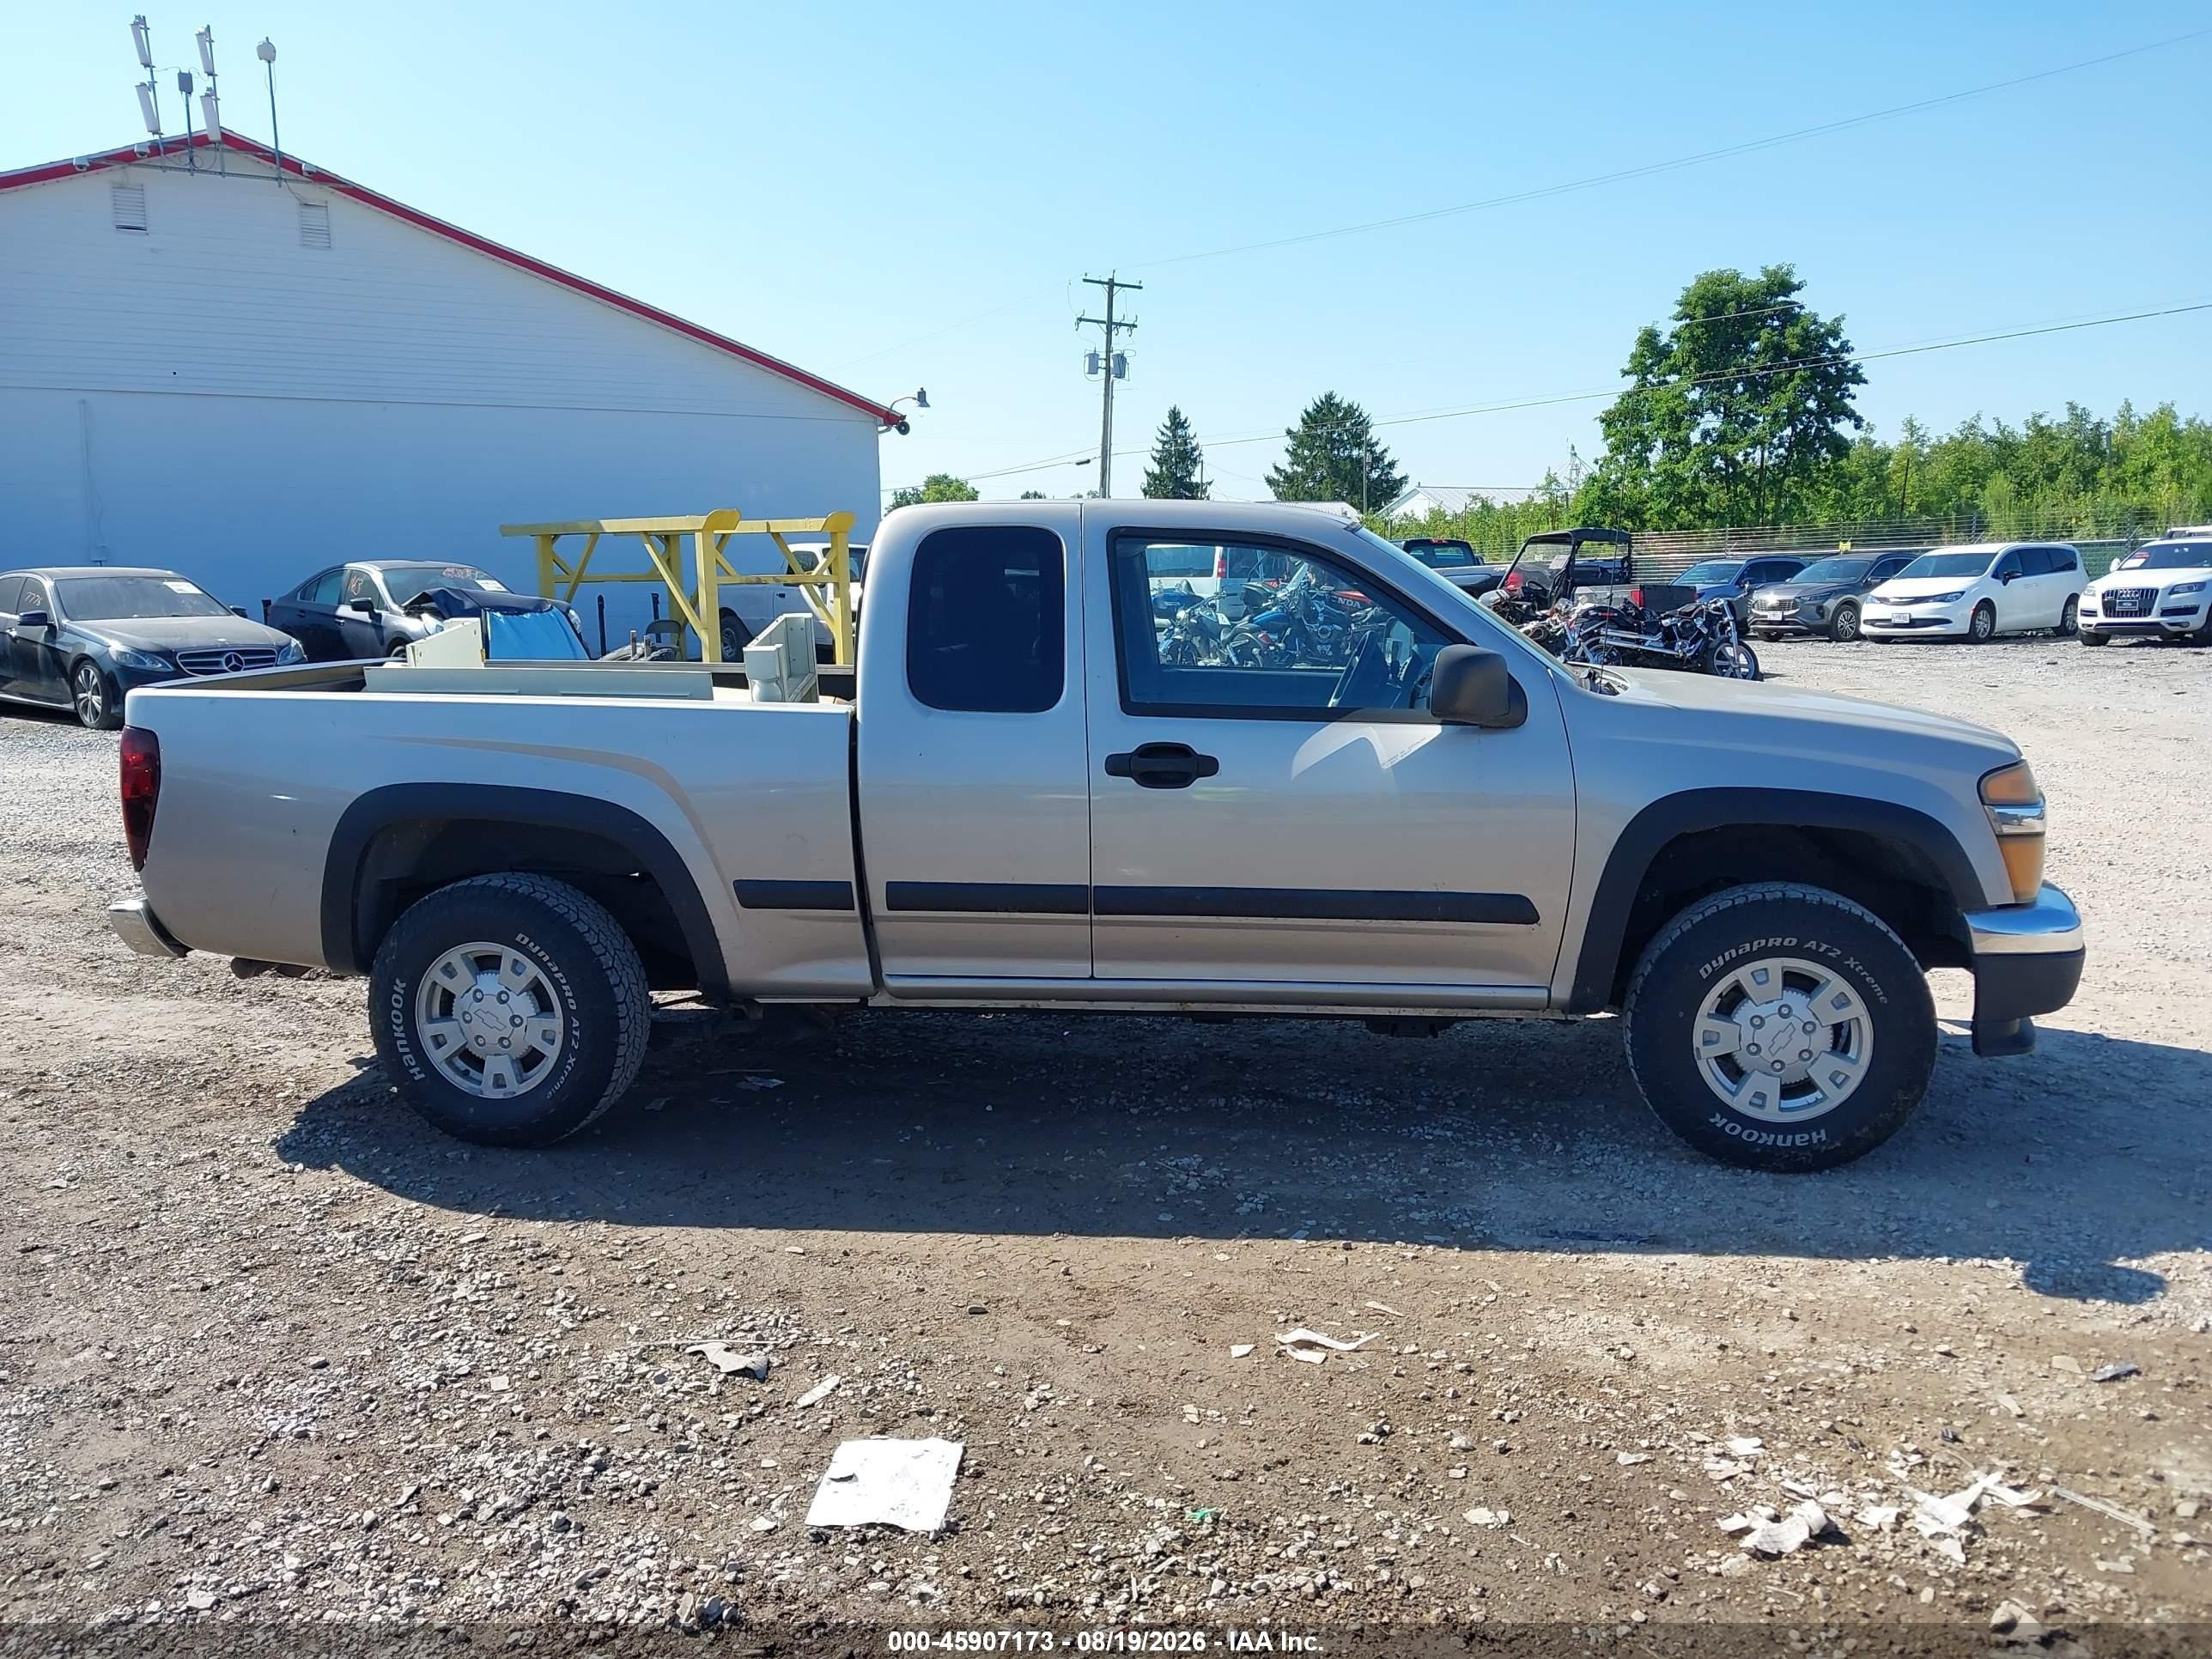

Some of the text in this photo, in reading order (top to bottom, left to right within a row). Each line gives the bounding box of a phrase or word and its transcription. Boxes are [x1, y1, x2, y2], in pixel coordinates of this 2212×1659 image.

[1804, 940, 1842, 959] AT2
[1844, 957, 1888, 1004] Xtreme
[570, 1017, 581, 1049] AT2
